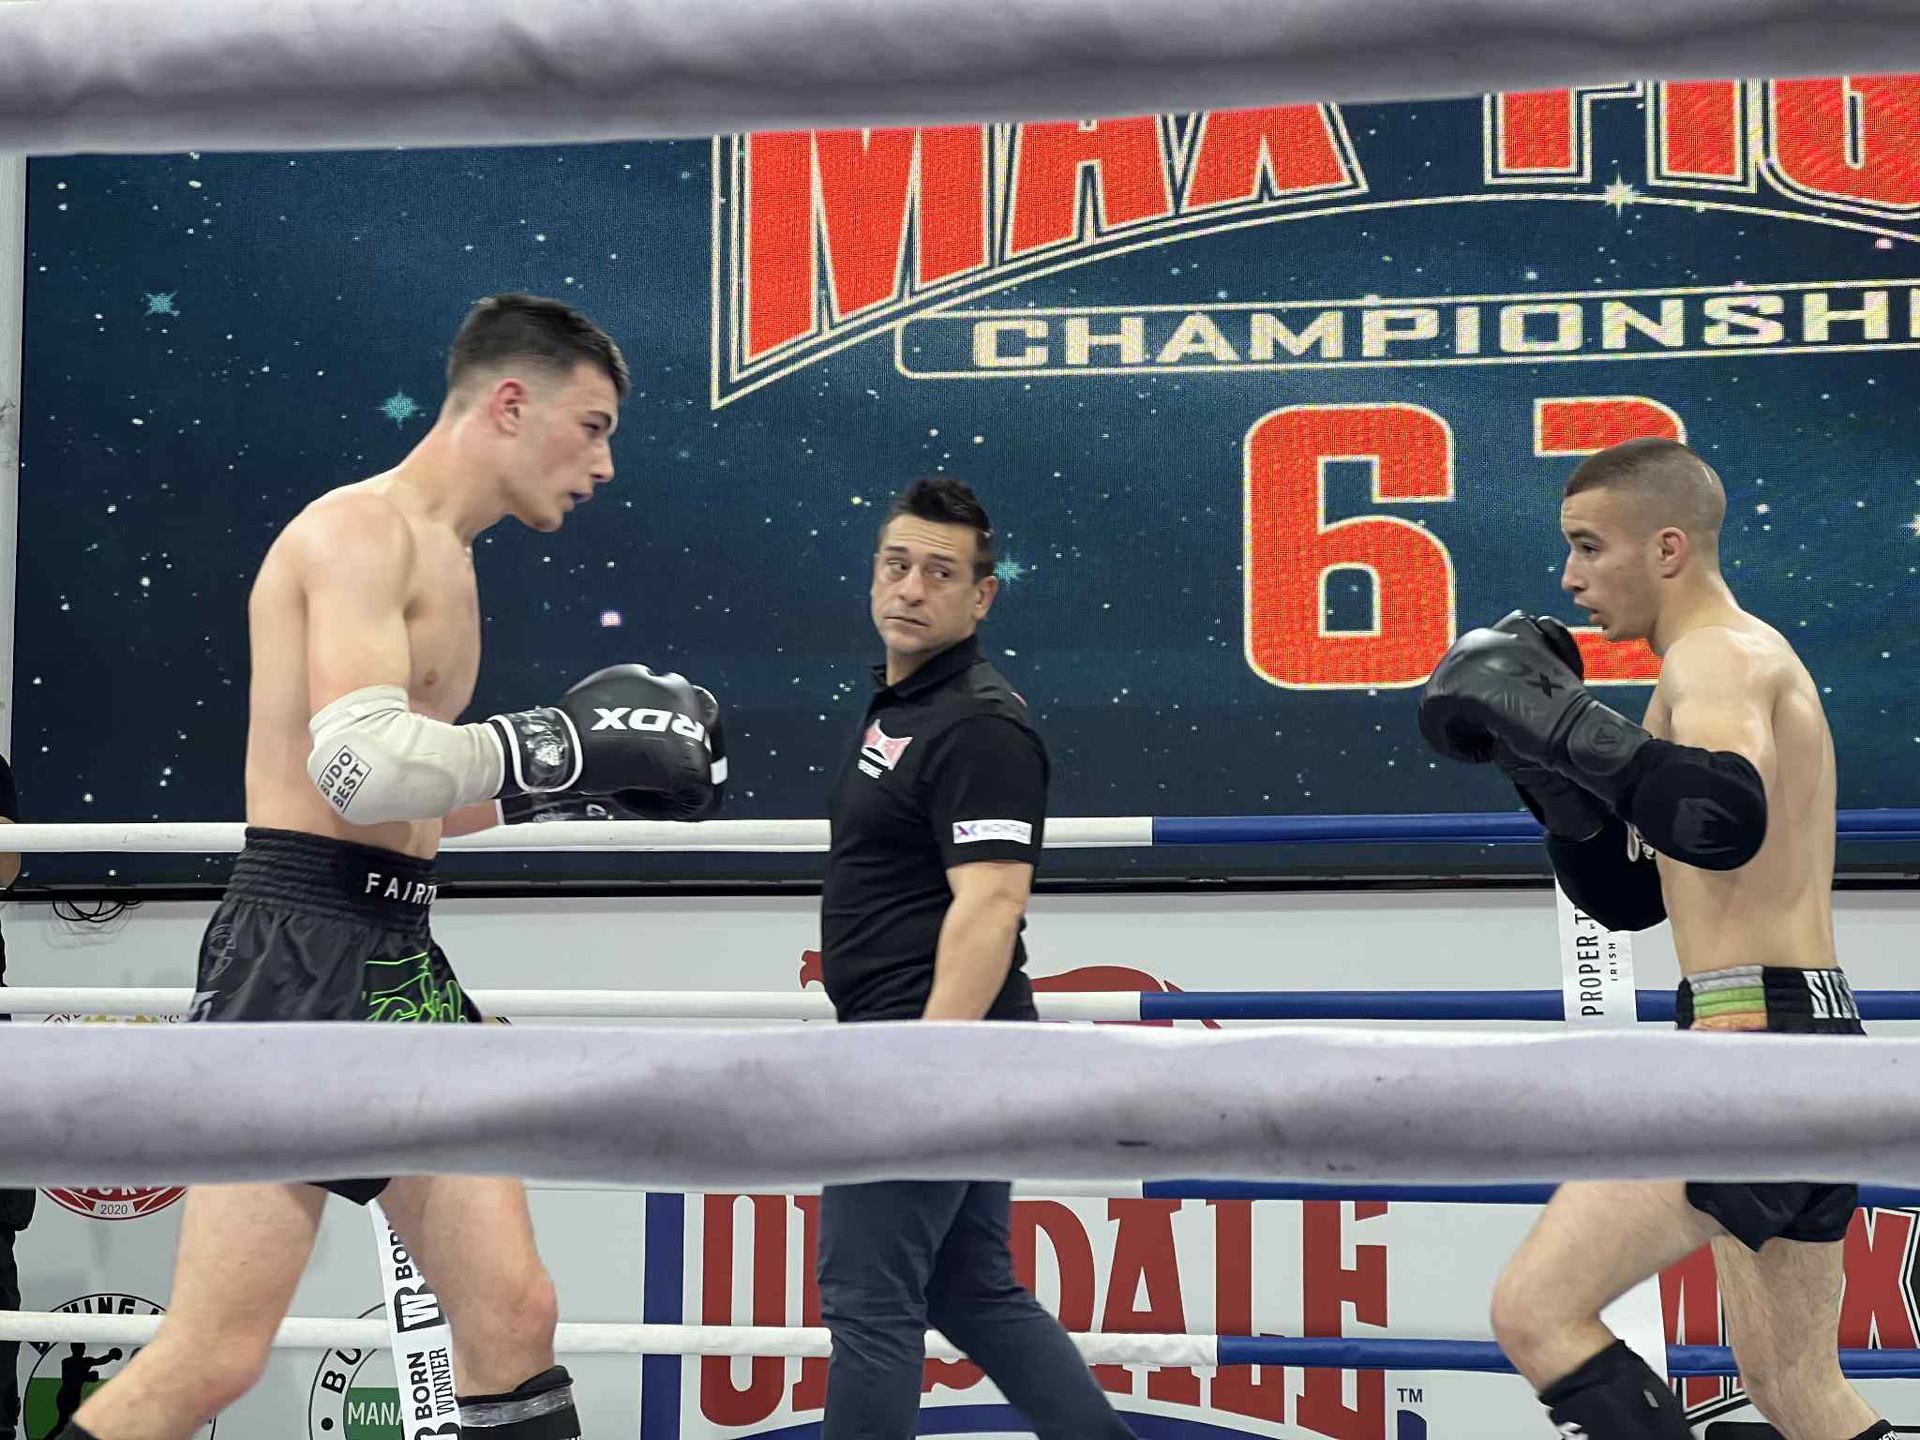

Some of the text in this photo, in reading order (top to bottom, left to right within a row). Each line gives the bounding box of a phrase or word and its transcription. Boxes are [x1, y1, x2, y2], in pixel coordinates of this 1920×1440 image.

[589, 706, 705, 742] RDX
[331, 762, 364, 809] BEST
[1607, 942, 1619, 982] IRISH
[100, 1203, 129, 1216] 2020
[406, 1351, 433, 1421] BORN
[428, 1347, 456, 1417] WINNER
[1396, 1387, 1423, 1404] TM
